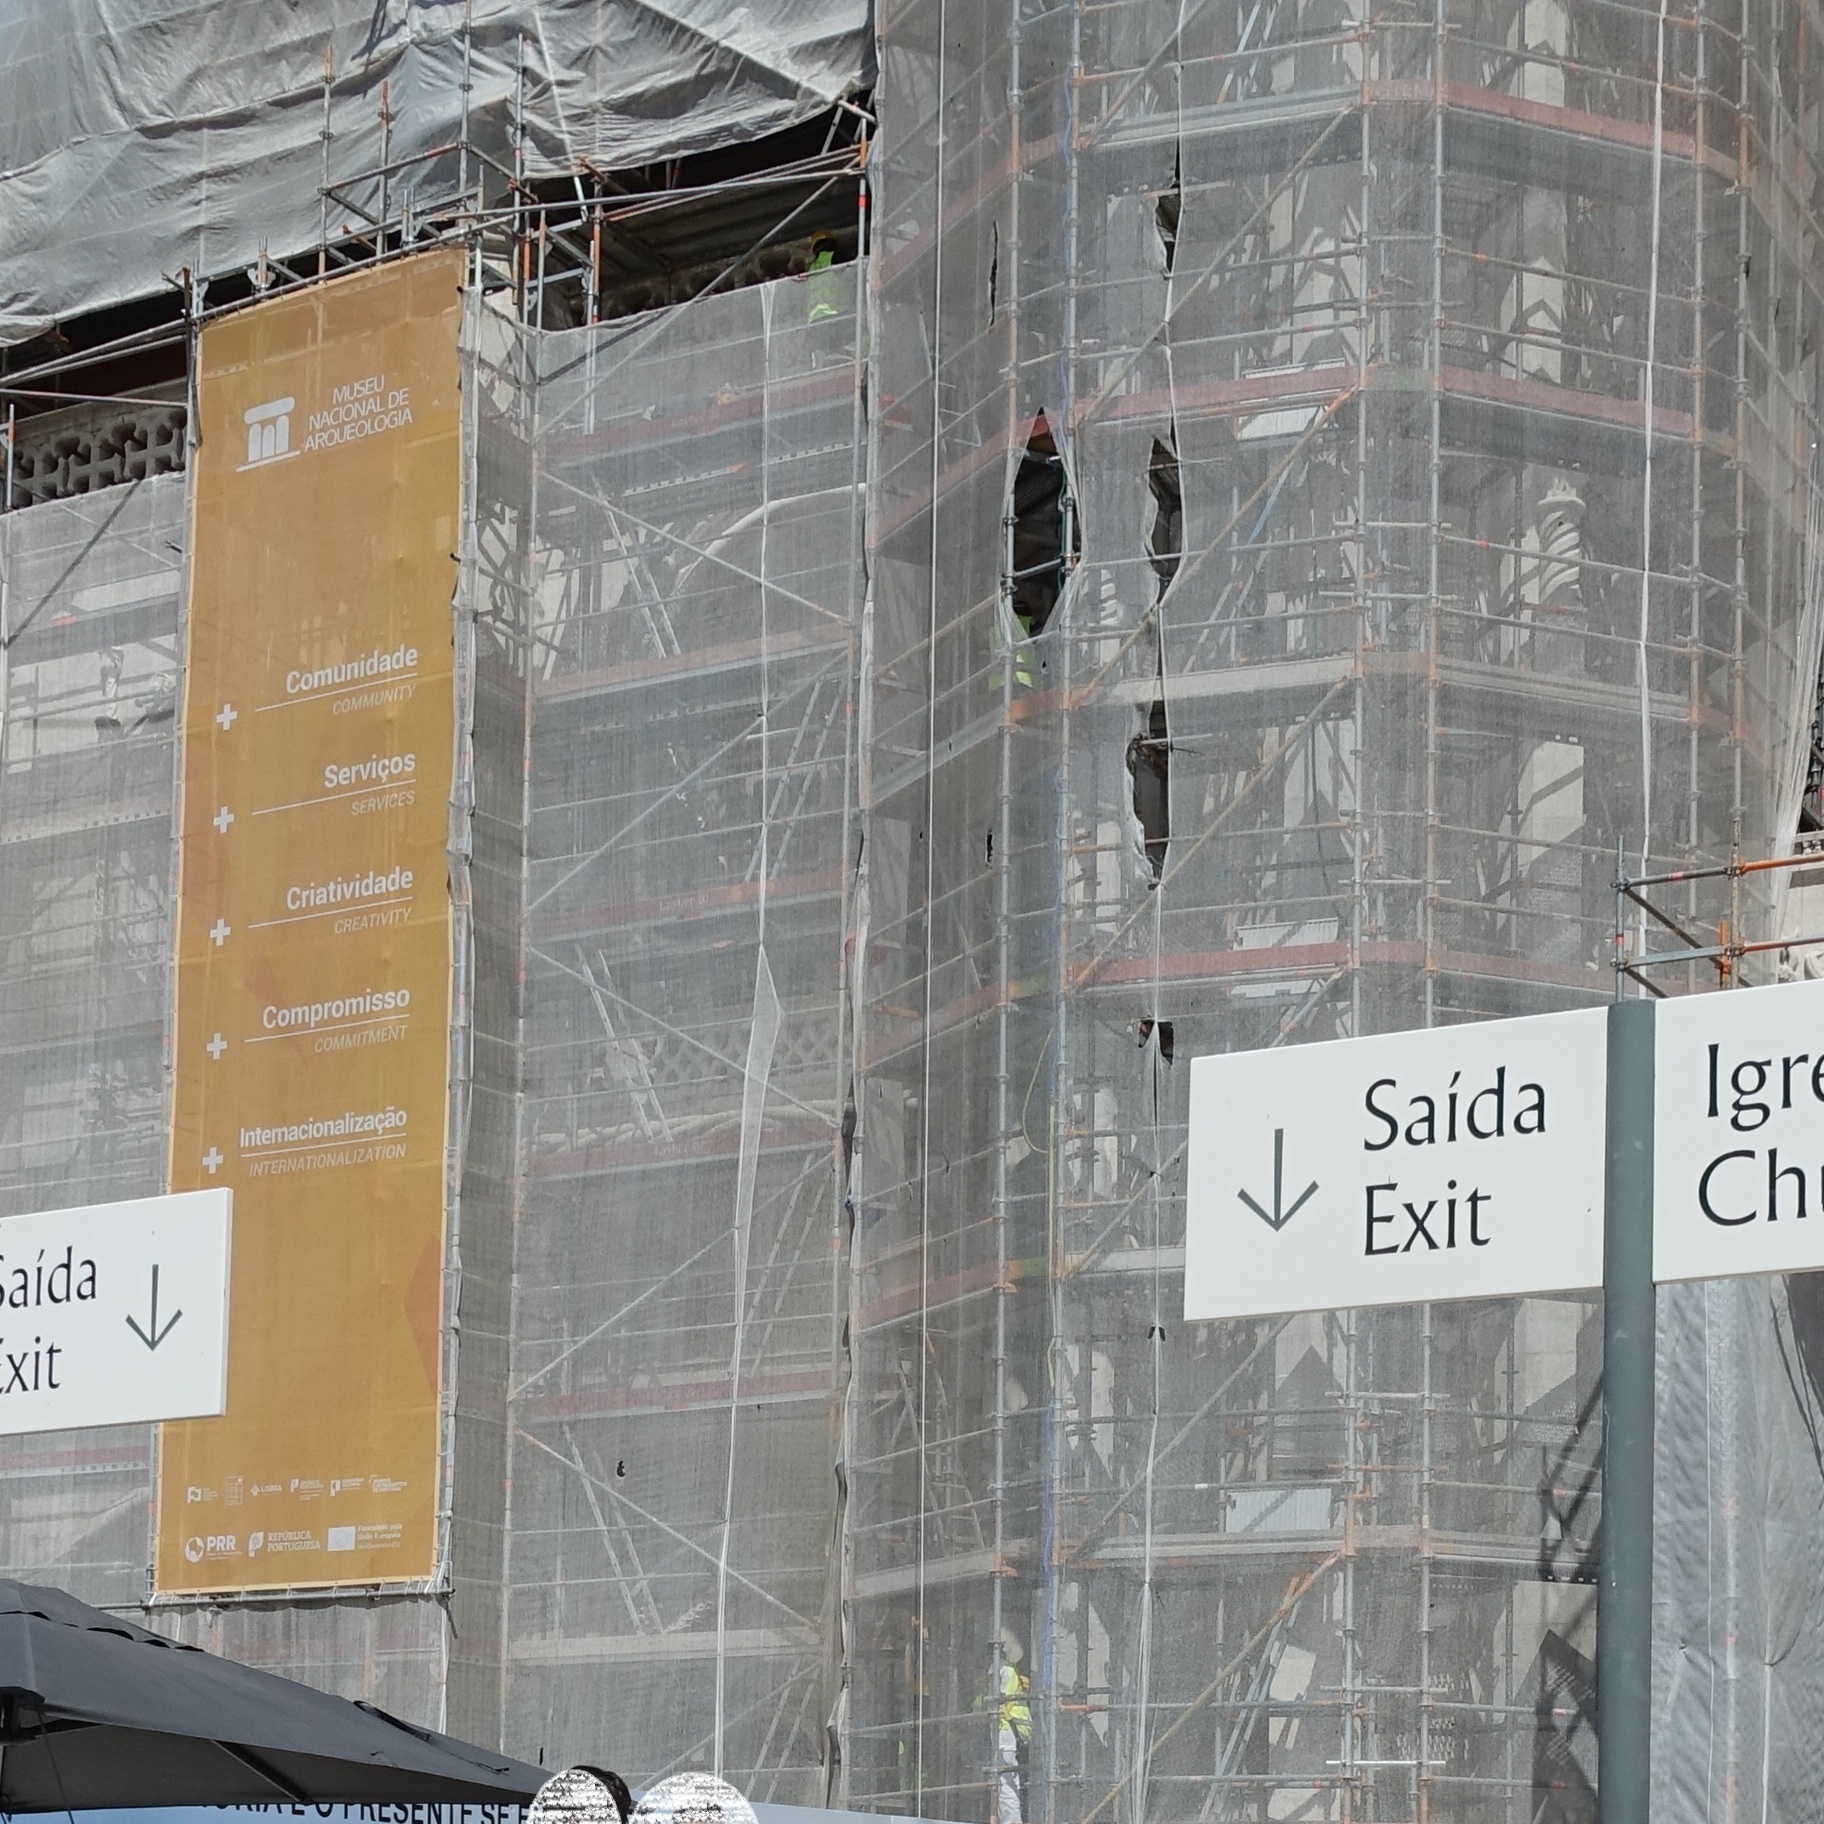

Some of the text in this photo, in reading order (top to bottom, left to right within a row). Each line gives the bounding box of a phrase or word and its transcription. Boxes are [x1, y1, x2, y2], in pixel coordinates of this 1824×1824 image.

[332, 375, 385, 404] MUSEU
[308, 387, 410, 431] NACIONAL DE
[304, 408, 413, 453] ARQUEOLOGIA
[286, 643, 418, 694] Comunidade
[333, 684, 416, 716] COMMUNITY
[324, 754, 416, 788] Serviços
[351, 790, 416, 816] SERVICES
[286, 865, 414, 911] Criatividade
[334, 907, 412, 935] CREATIVITY
[262, 987, 410, 1029] Compromisso
[314, 1025, 409, 1053] COMMITMENT
[1363, 1065, 1549, 1153] Saída
[239, 1106, 408, 1148] Internacionalização
[249, 1143, 407, 1177] INTERNATIONALIZATION
[1362, 1178, 1493, 1258] Exit
[206, 1535, 236, 1552] PRR
[267, 1540, 321, 1552] PORTUGUESA
[268, 1530, 312, 1542] REPÚBLICA
